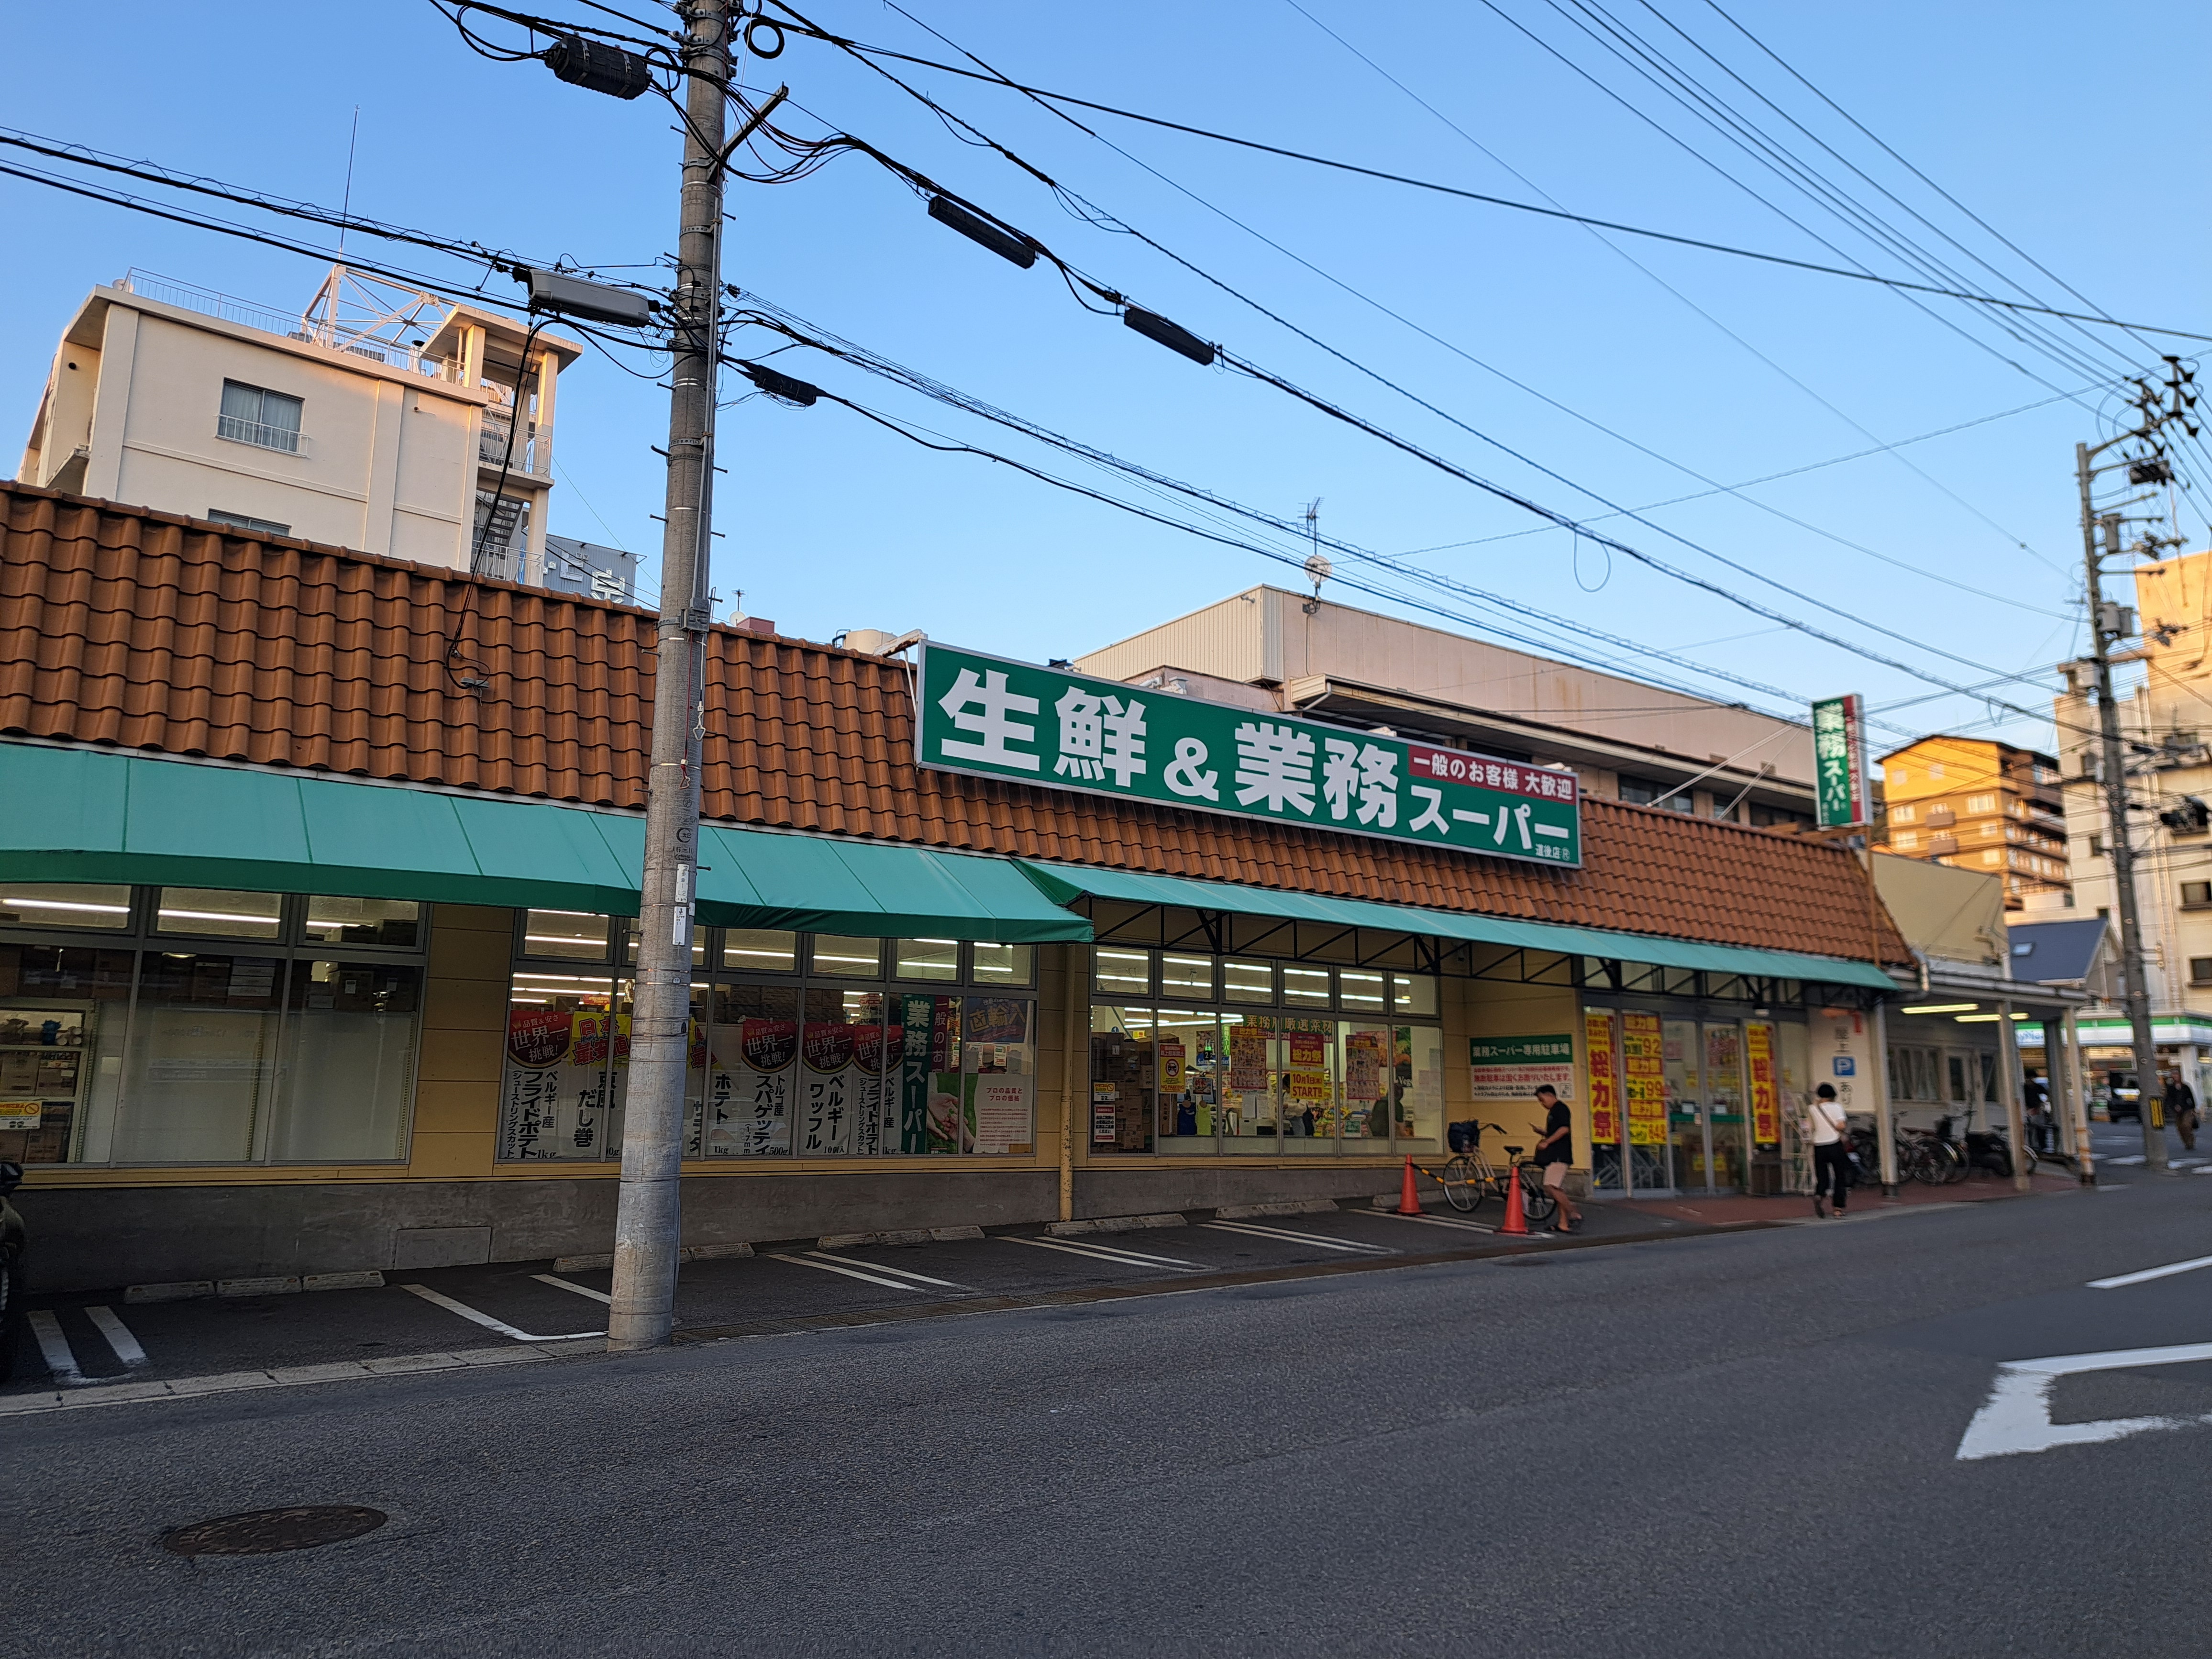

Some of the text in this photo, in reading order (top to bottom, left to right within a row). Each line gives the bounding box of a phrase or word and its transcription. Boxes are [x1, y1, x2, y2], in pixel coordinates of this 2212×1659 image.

[1414, 753, 1573, 800] 一般のお客様 大歓迎
[523, 1014, 559, 1028] 品質&安さ
[969, 1003, 1026, 1033] 直輸入
[755, 1023, 785, 1036] 品質&安さ
[814, 1026, 844, 1039] 品質&安さ
[865, 1028, 892, 1040] 品質&さ
[529, 1044, 558, 1062] 挑戦!
[1292, 1048, 1322, 1062] 総力祭
[1472, 1042, 1570, 1058] 業務スーパー専用駐車場
[760, 1052, 785, 1067] 挑戦!
[819, 1053, 844, 1068] 挑戦!
[1836, 1058, 1852, 1074] P
[904, 1000, 930, 1154] 業務スーパー
[542, 1070, 558, 1128] ベルギー産
[774, 1075, 785, 1116] トルコ産
[1292, 1086, 1322, 1097] START!!
[1590, 1049, 1612, 1138] 総力祭
[828, 1075, 845, 1140] ベルギー
[884, 1077, 895, 1128] ベルギー産
[518, 1071, 544, 1158] フライドポテト
[574, 1089, 597, 1147] だし巻
[752, 1075, 774, 1154] スパゲッティ
[806, 1084, 824, 1150] ワッフル
[714, 1146, 729, 1154] 1kg
[769, 1146, 789, 1155] 500g
[823, 1146, 844, 1154] 10個入
